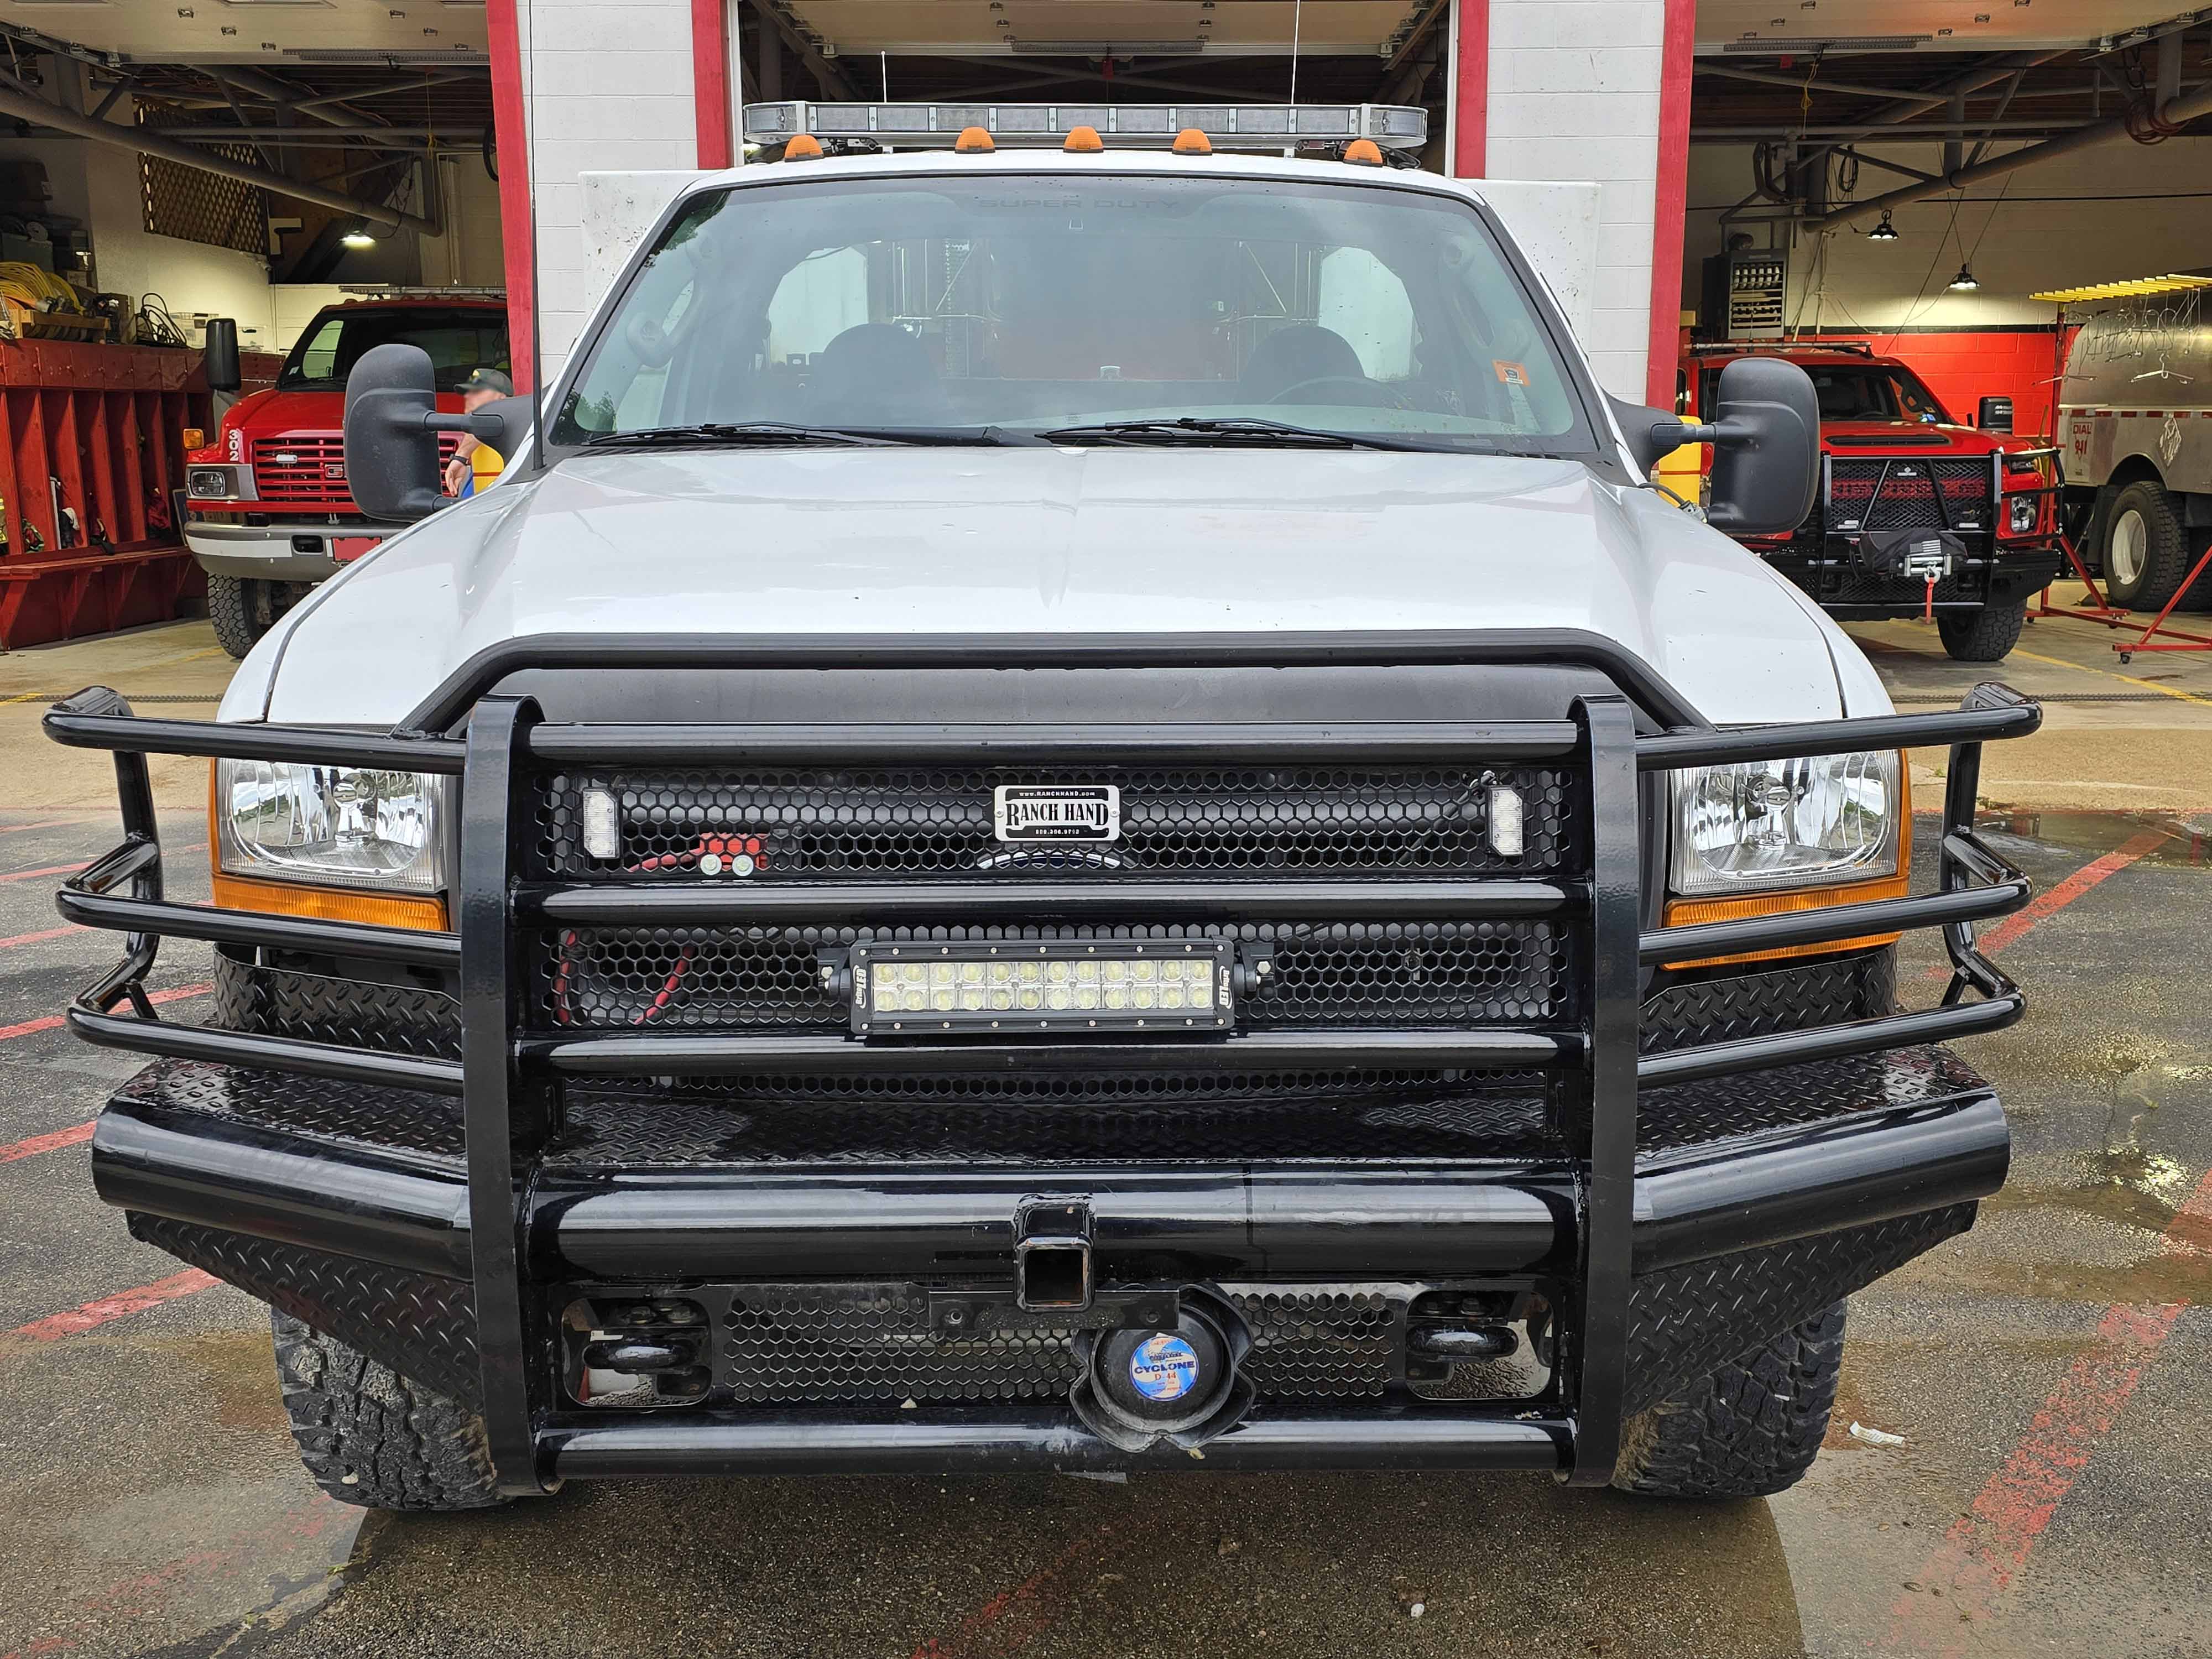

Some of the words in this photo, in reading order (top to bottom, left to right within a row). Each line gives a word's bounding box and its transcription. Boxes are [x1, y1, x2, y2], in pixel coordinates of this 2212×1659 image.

[979, 200, 1081, 208] SUPER
[1094, 200, 1179, 208] DUTY
[2073, 424, 2091, 434] DIAL
[229, 430, 239, 461] 302
[2075, 440, 2088, 455] 911
[1005, 803, 1059, 826] RANCH
[1065, 803, 1109, 826] HAND
[1134, 1361, 1195, 1374] CYCLONE
